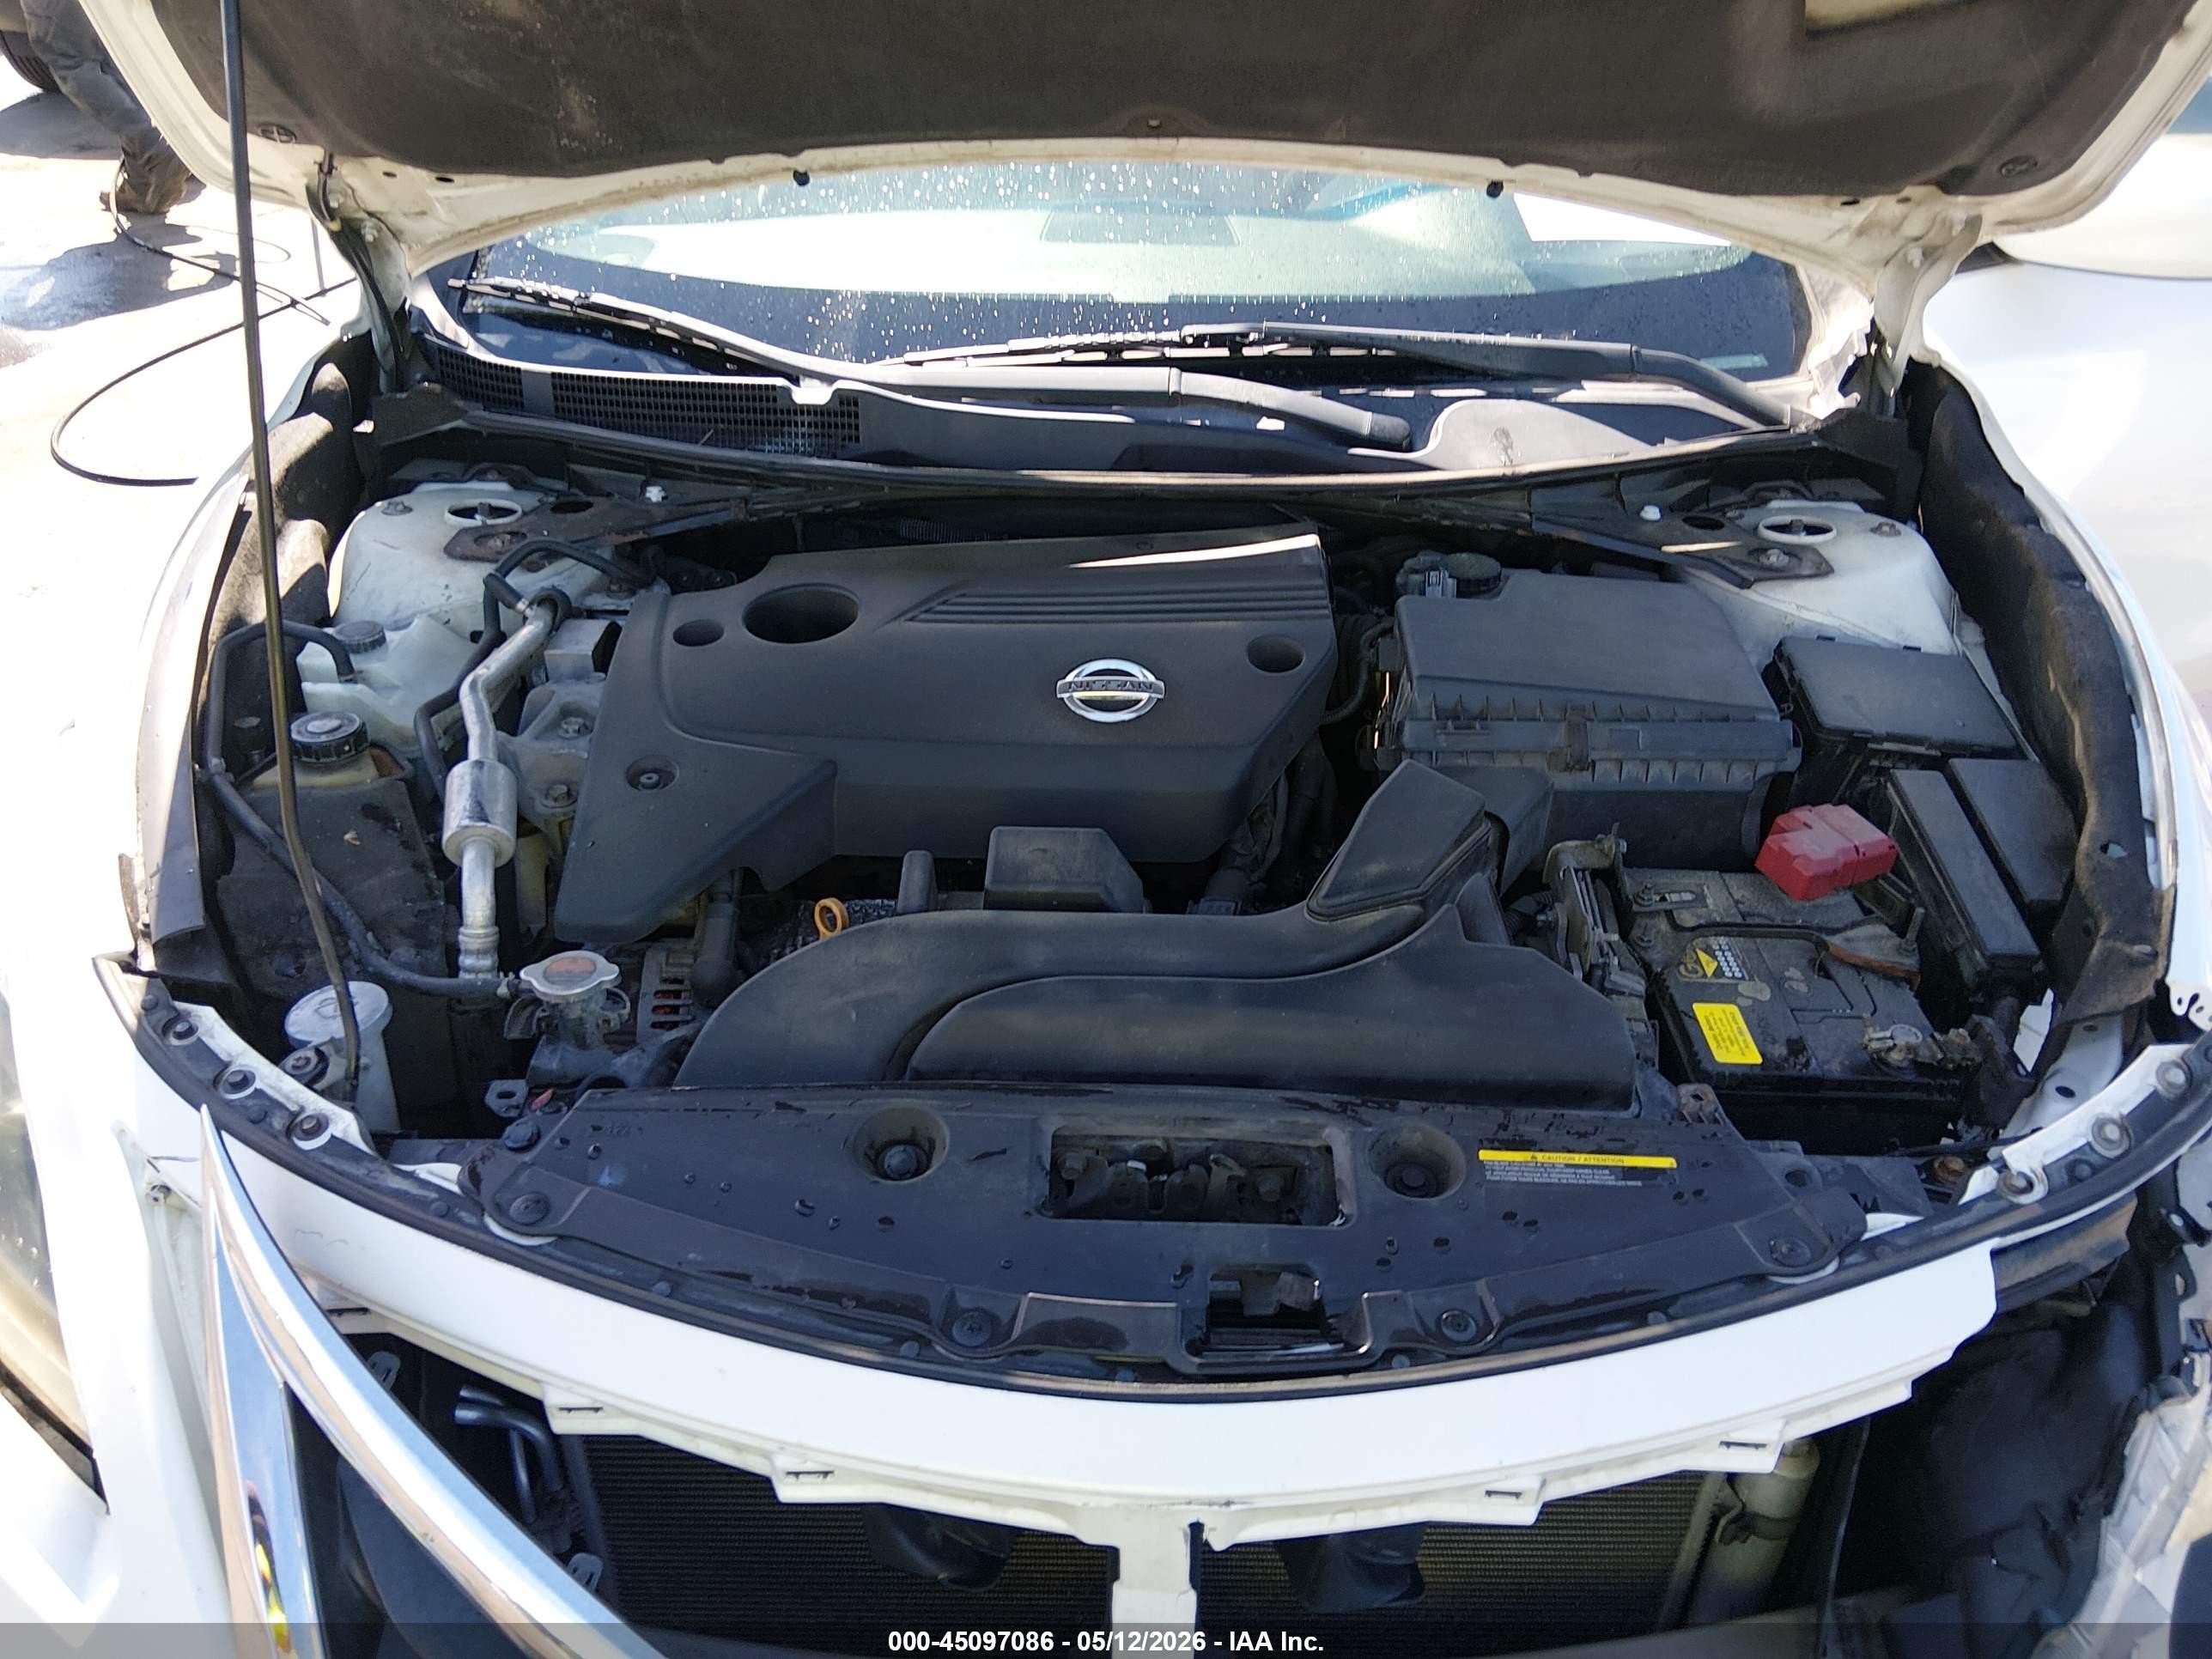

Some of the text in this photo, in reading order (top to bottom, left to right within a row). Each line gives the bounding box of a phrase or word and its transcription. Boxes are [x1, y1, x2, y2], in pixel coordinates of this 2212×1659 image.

[1067, 680, 1154, 692] NISSAN
[1541, 1153, 1576, 1163] CAUTION
[1582, 1155, 1626, 1165] ATTENTION
